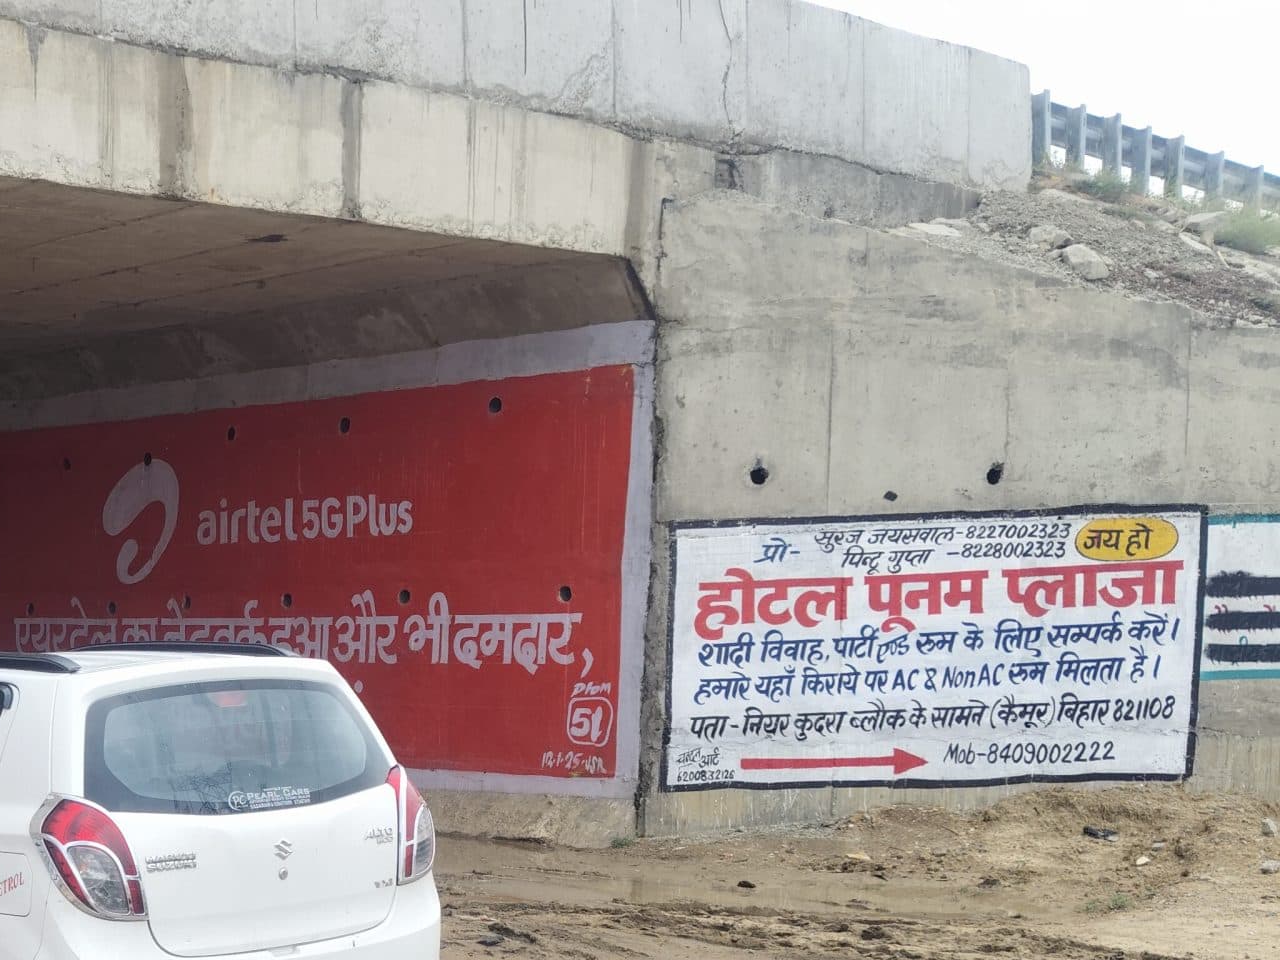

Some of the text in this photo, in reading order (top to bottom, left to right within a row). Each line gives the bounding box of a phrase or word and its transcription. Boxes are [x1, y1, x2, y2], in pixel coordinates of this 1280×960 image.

[196, 494, 413, 545] airtel 5G Plus
[1082, 523, 1153, 556] जय हो
[332, 589, 399, 664] और
[403, 591, 453, 665] भी
[694, 560, 1184, 641] होटल पूनम प्लाजा
[698, 632, 755, 669] शादी
[832, 625, 880, 659] पार्टी
[961, 621, 985, 650] के
[994, 618, 1044, 657] लिए
[1046, 611, 1124, 649] सम्पर्क
[694, 672, 752, 706] हमारे
[755, 664, 796, 702] यहाँ
[801, 663, 861, 695] किराये
[864, 669, 889, 694] पर
[892, 668, 919, 691] AC
[923, 667, 937, 692] &
[1056, 651, 1126, 686] मिलता
[794, 710, 848, 741] कुदरा
[910, 699, 928, 730] के
[931, 699, 989, 729] सामने
[1057, 692, 1111, 730] बिहार
[1113, 695, 1176, 723] 821108
[247, 791, 279, 801] PEARL
